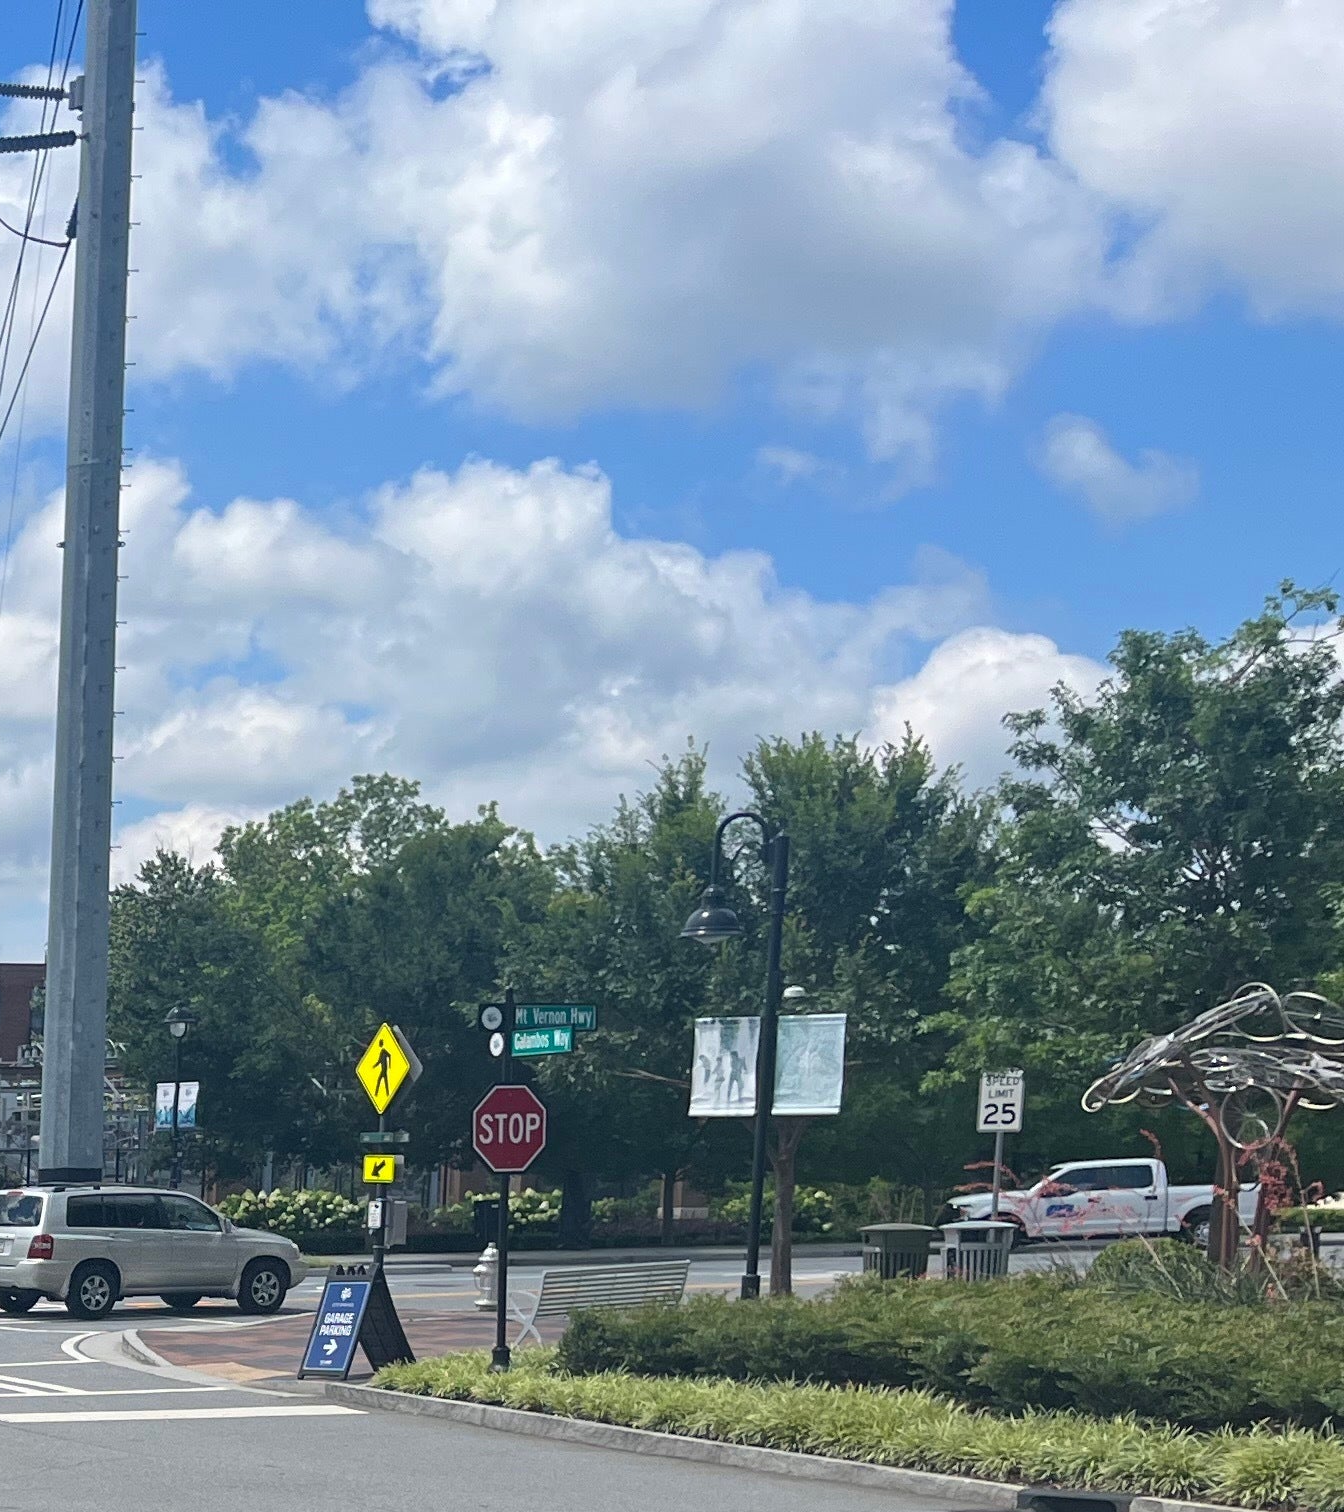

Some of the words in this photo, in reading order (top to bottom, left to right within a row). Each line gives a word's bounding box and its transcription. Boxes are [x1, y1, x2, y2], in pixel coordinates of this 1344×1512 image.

[515, 1008, 528, 1024] Mt
[533, 1008, 567, 1025] Vernon
[570, 1008, 593, 1028] Hwy
[514, 1033, 549, 1050] Galambos
[553, 1030, 571, 1049] Way
[986, 1074, 1020, 1087] SPEED
[988, 1089, 1015, 1099] LIMIT
[983, 1103, 1016, 1125] 25
[479, 1112, 541, 1145] STOP
[324, 1312, 355, 1324] GARAGE
[319, 1324, 352, 1336] PARKING
